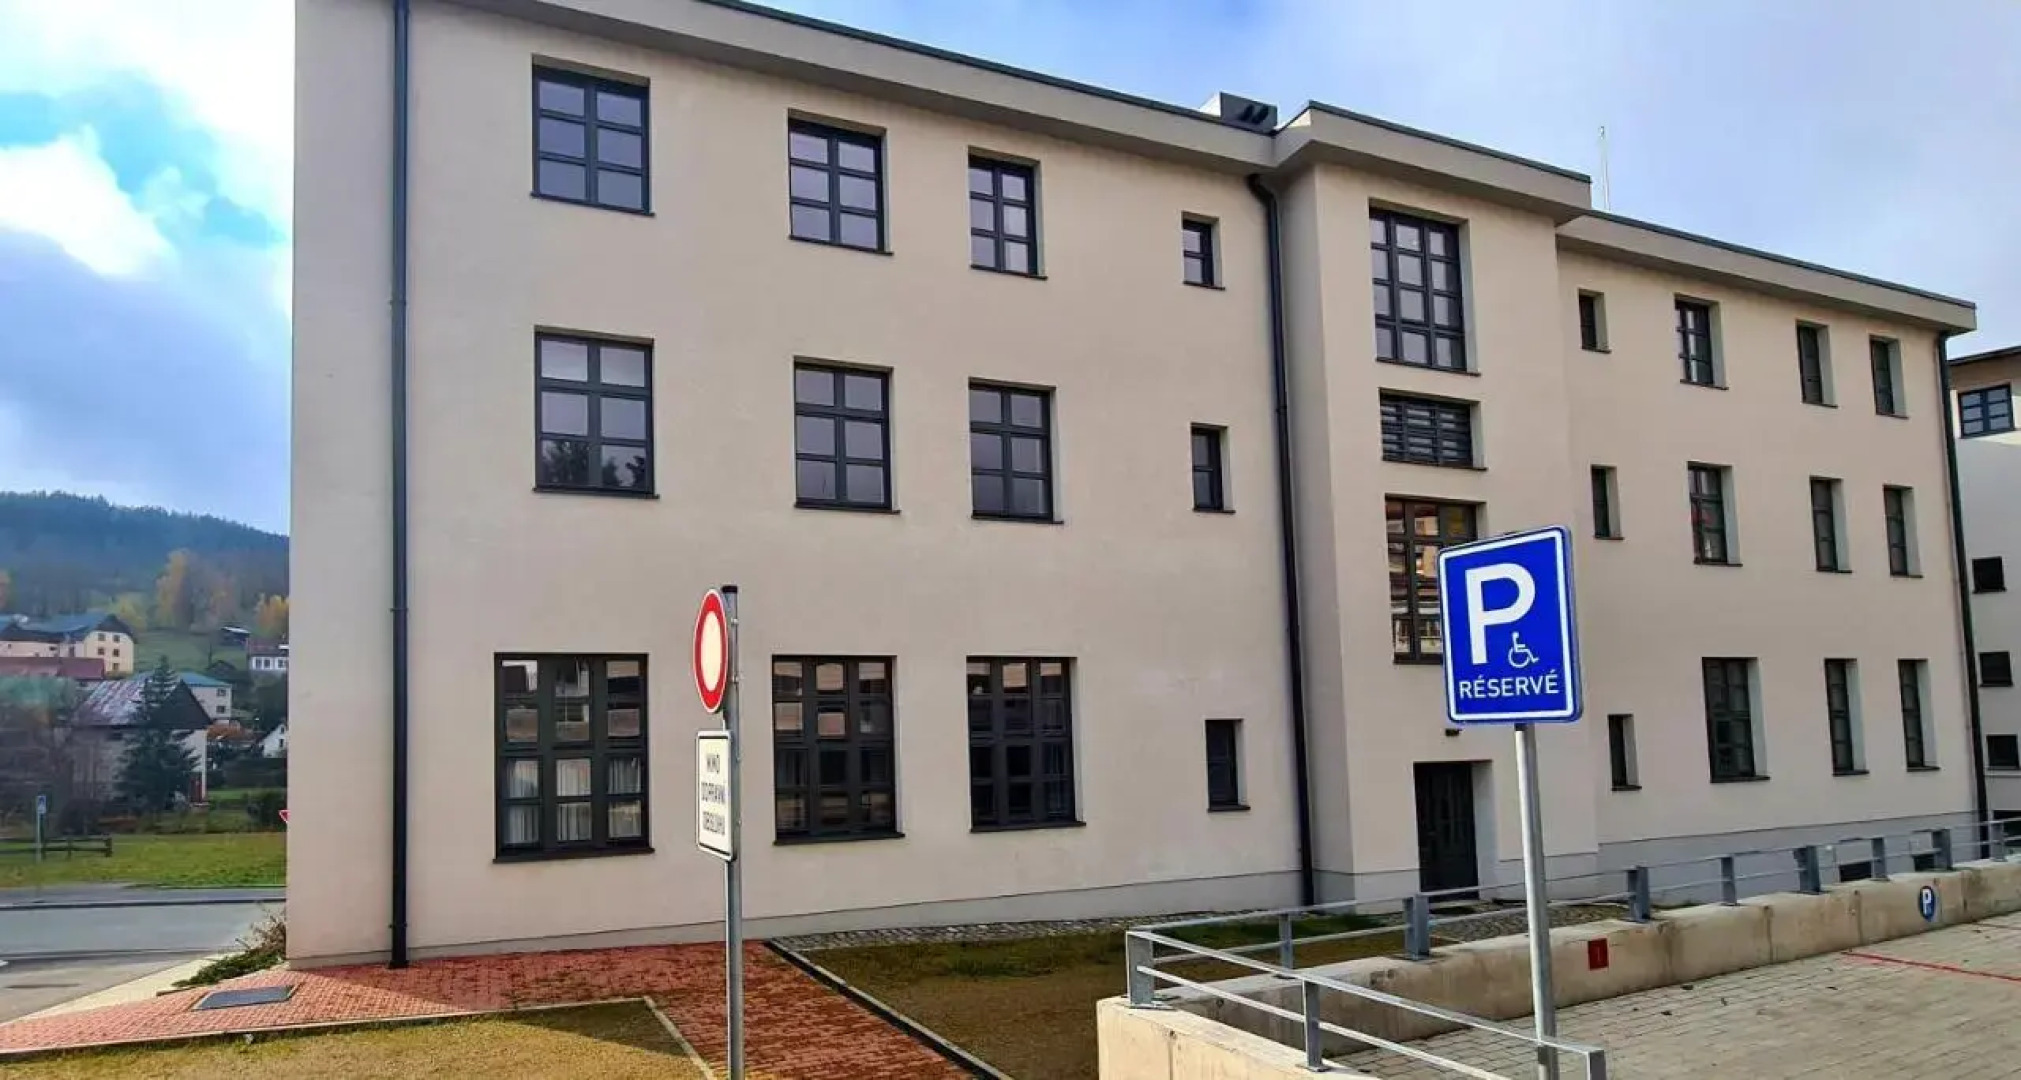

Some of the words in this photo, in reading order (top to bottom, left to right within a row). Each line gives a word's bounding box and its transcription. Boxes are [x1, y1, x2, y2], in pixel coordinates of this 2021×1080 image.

[1464, 562, 1536, 666] P
[1458, 669, 1560, 700] RÉSERVÉ
[1922, 889, 1932, 915] P
